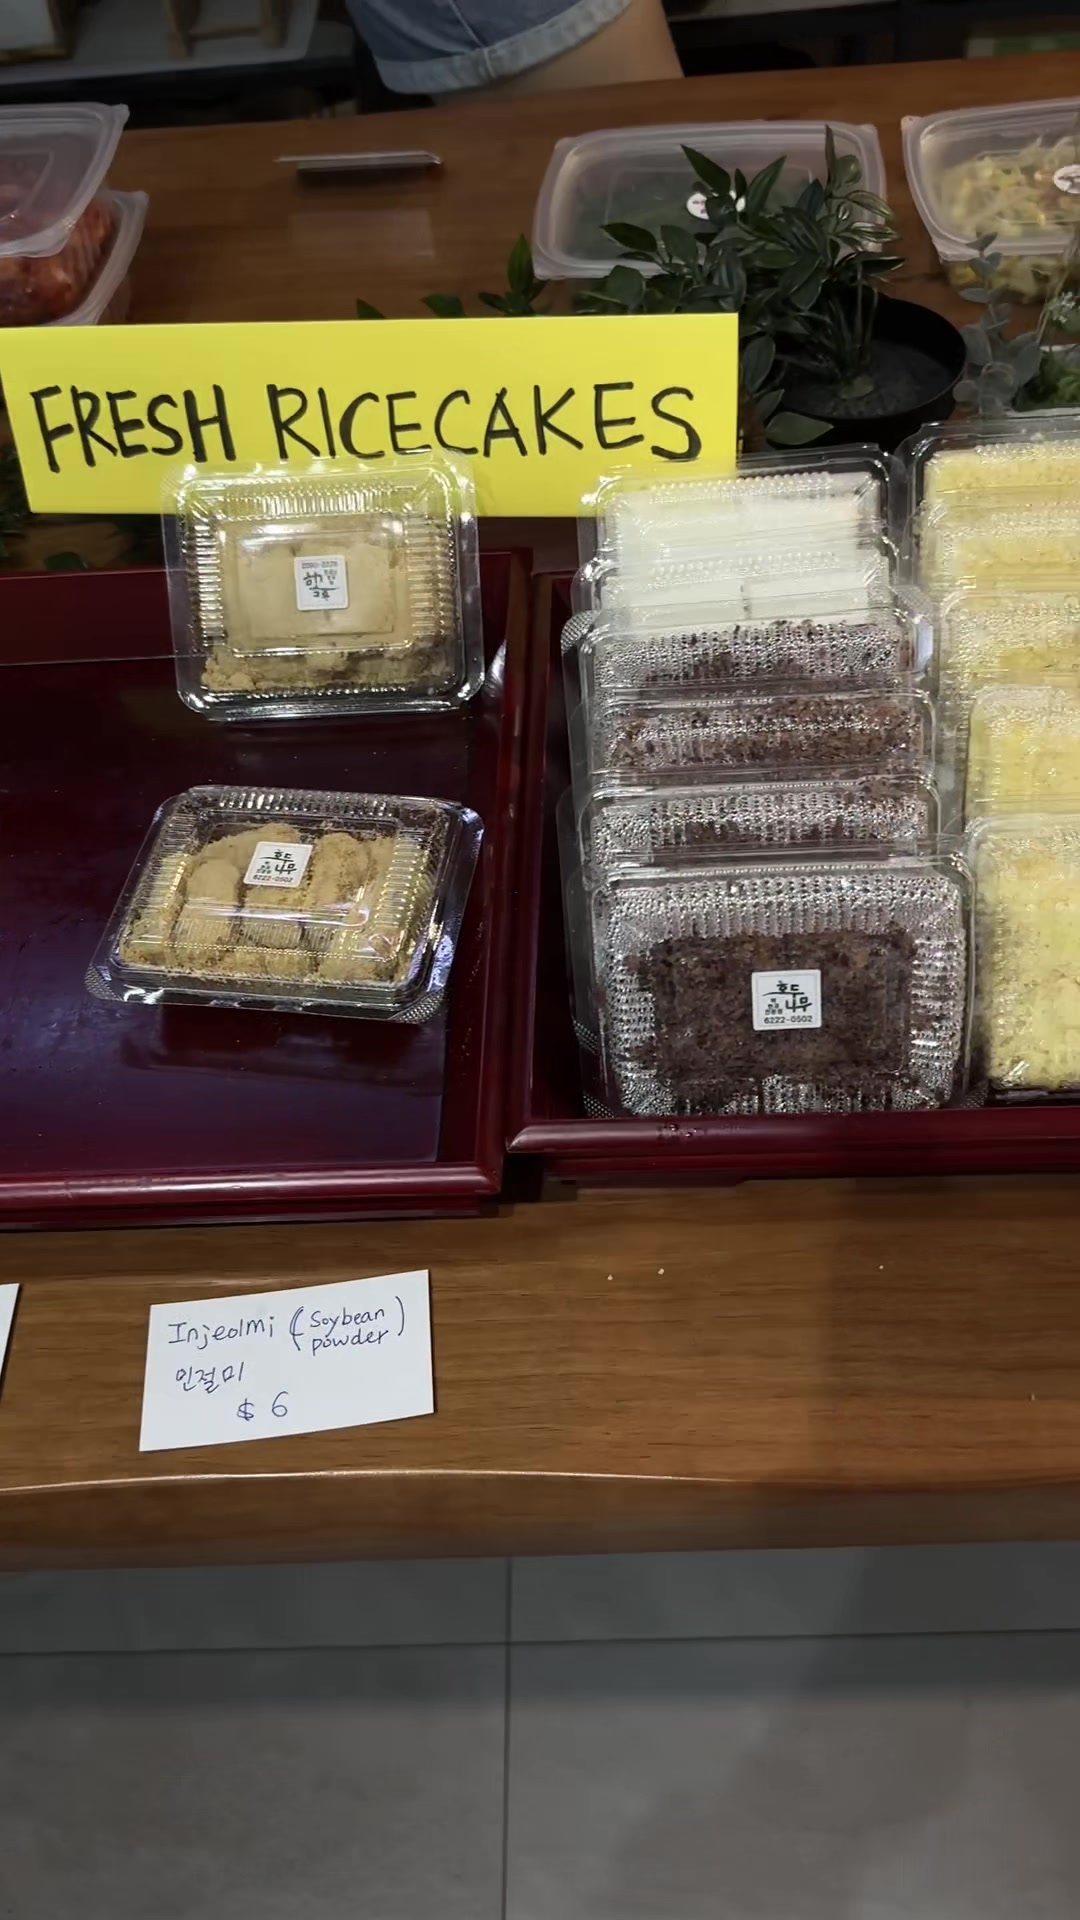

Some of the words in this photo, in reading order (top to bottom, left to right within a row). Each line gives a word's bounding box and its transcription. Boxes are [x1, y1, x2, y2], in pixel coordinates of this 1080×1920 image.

[29, 384, 236, 473] FRESH
[267, 381, 702, 462] RICECAKES
[762, 980, 805, 996] 호두
[785, 995, 813, 1013] 나무
[763, 1015, 814, 1025] 6222-0502
[167, 1315, 275, 1350] Injeolmi
[175, 1361, 245, 1394] 인절미
